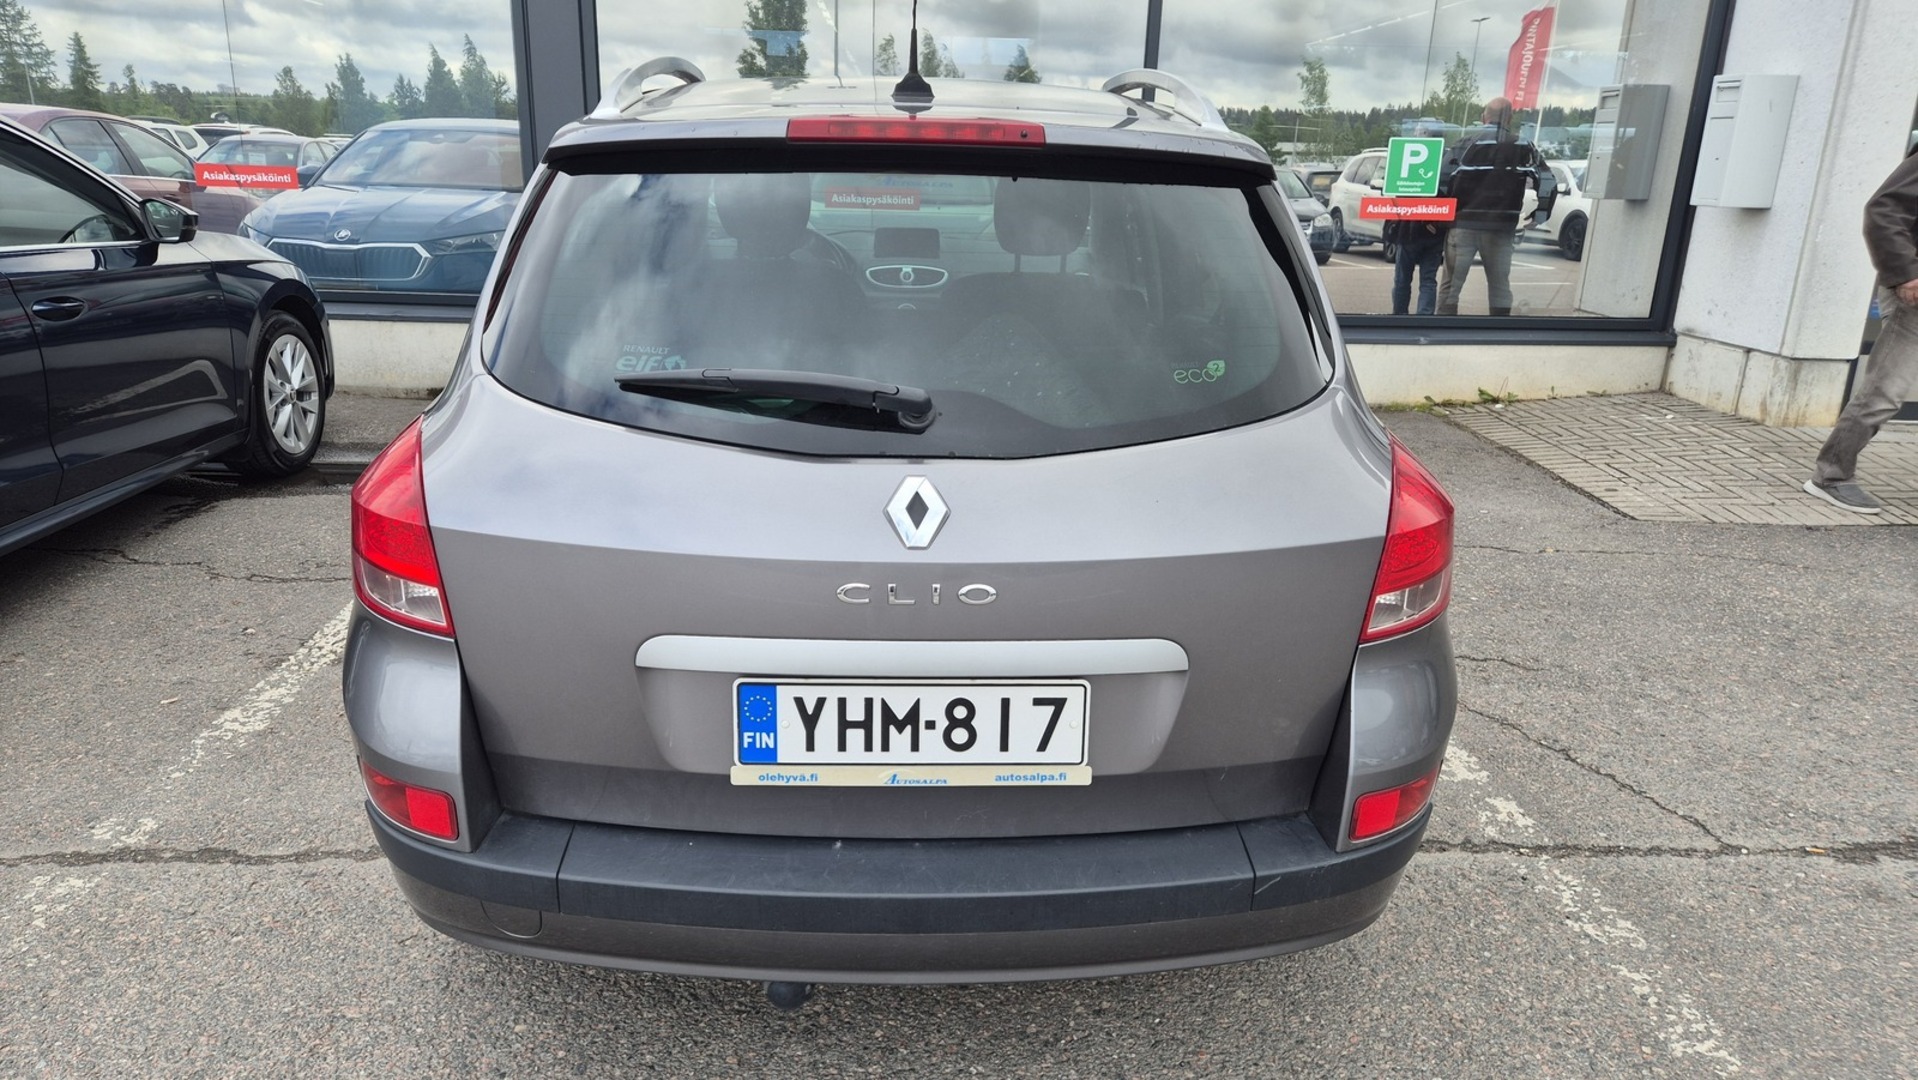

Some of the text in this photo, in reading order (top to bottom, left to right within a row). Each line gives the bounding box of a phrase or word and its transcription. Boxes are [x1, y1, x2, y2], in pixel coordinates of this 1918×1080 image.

[1400, 143, 1429, 178] P
[203, 171, 291, 183] Asiakaspysäköinti
[831, 193, 914, 206] Asiakaspysäköinti
[1366, 204, 1449, 216] Asiakaspysäköinti
[623, 344, 671, 355] RENAULT
[615, 354, 663, 372] elf
[836, 582, 997, 605] CLIO
[793, 696, 1068, 753] YHM-817
[743, 731, 775, 748] FIN
[758, 772, 1068, 785] olehyvä.fi AUTOSALPA autosalpa.fi
